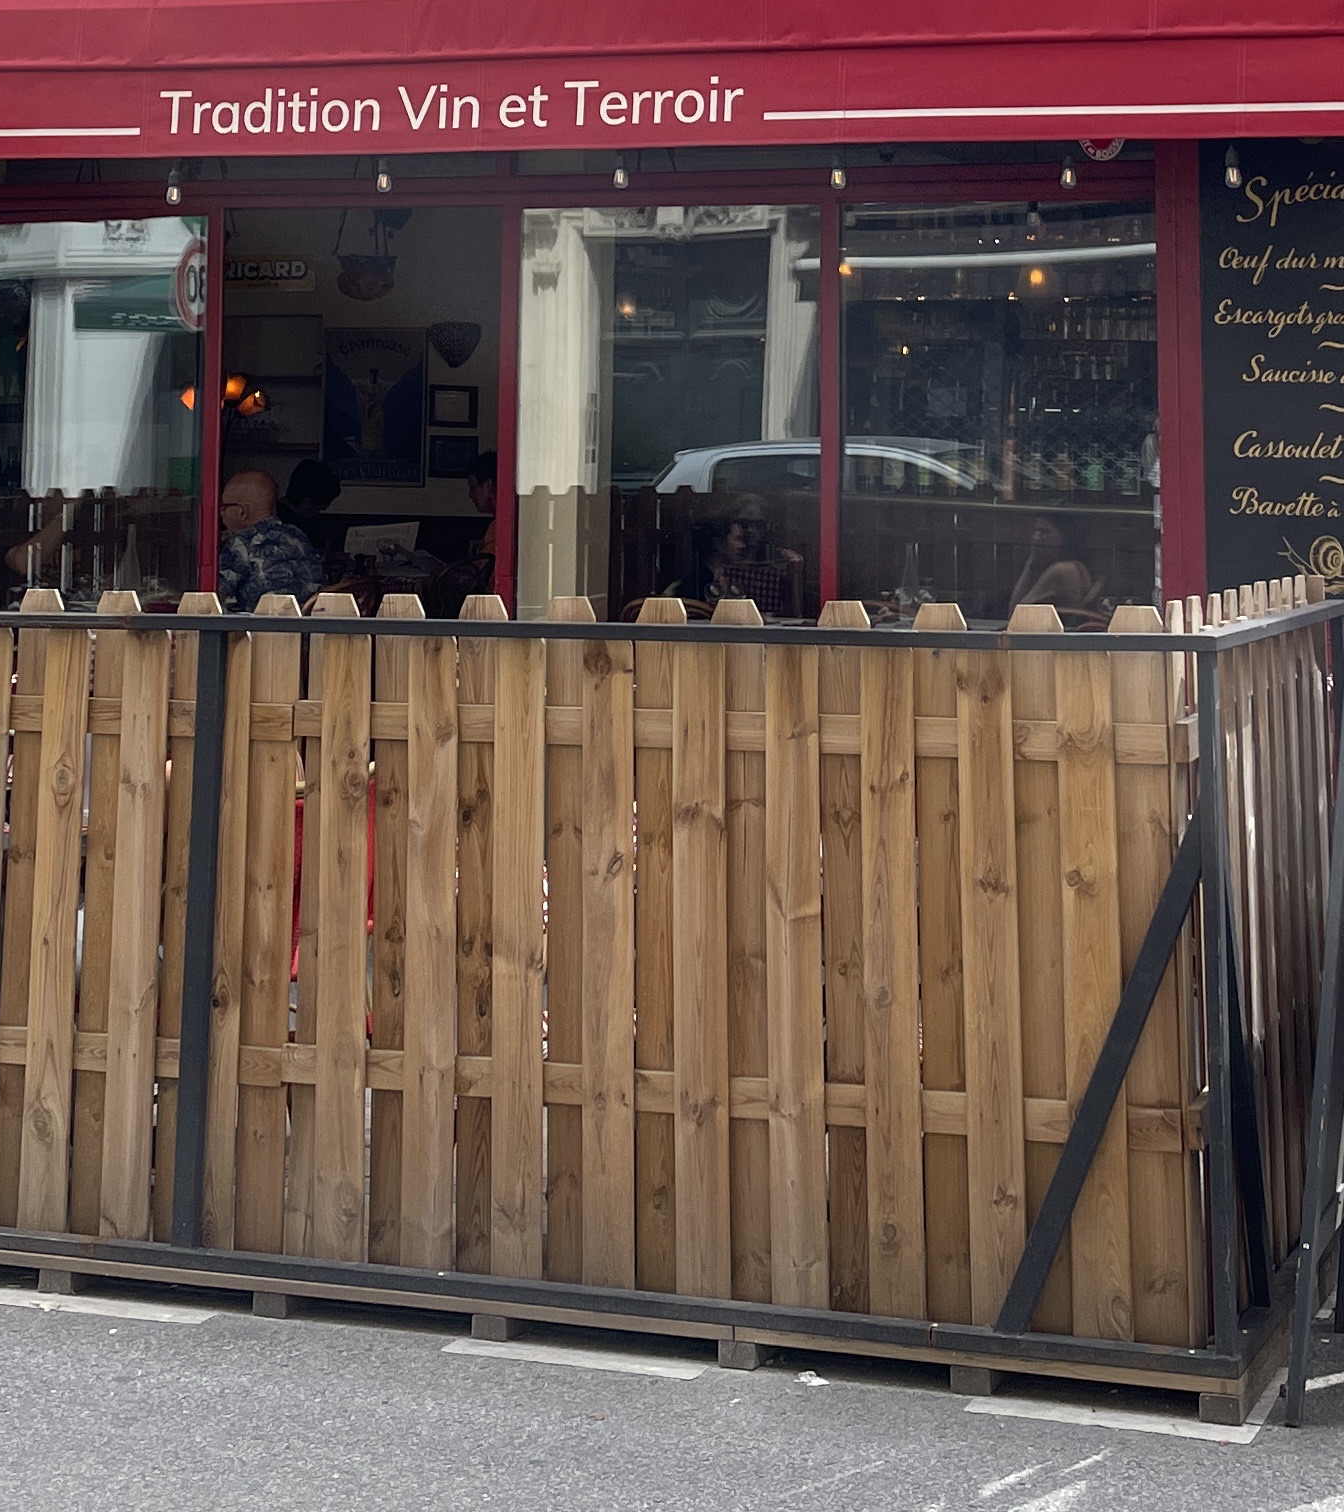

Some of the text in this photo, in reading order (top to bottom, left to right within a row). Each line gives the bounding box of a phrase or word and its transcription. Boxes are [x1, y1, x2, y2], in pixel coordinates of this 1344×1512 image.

[160, 76, 744, 136] Tradition Vin et Terroir
[1275, 248, 1319, 270] dur
[1214, 298, 1314, 338] Escargots
[1242, 354, 1337, 386] Saucisse
[1233, 430, 1343, 460] Cassoulet
[1229, 486, 1325, 519] Bavette
[1326, 497, 1342, 518] à
